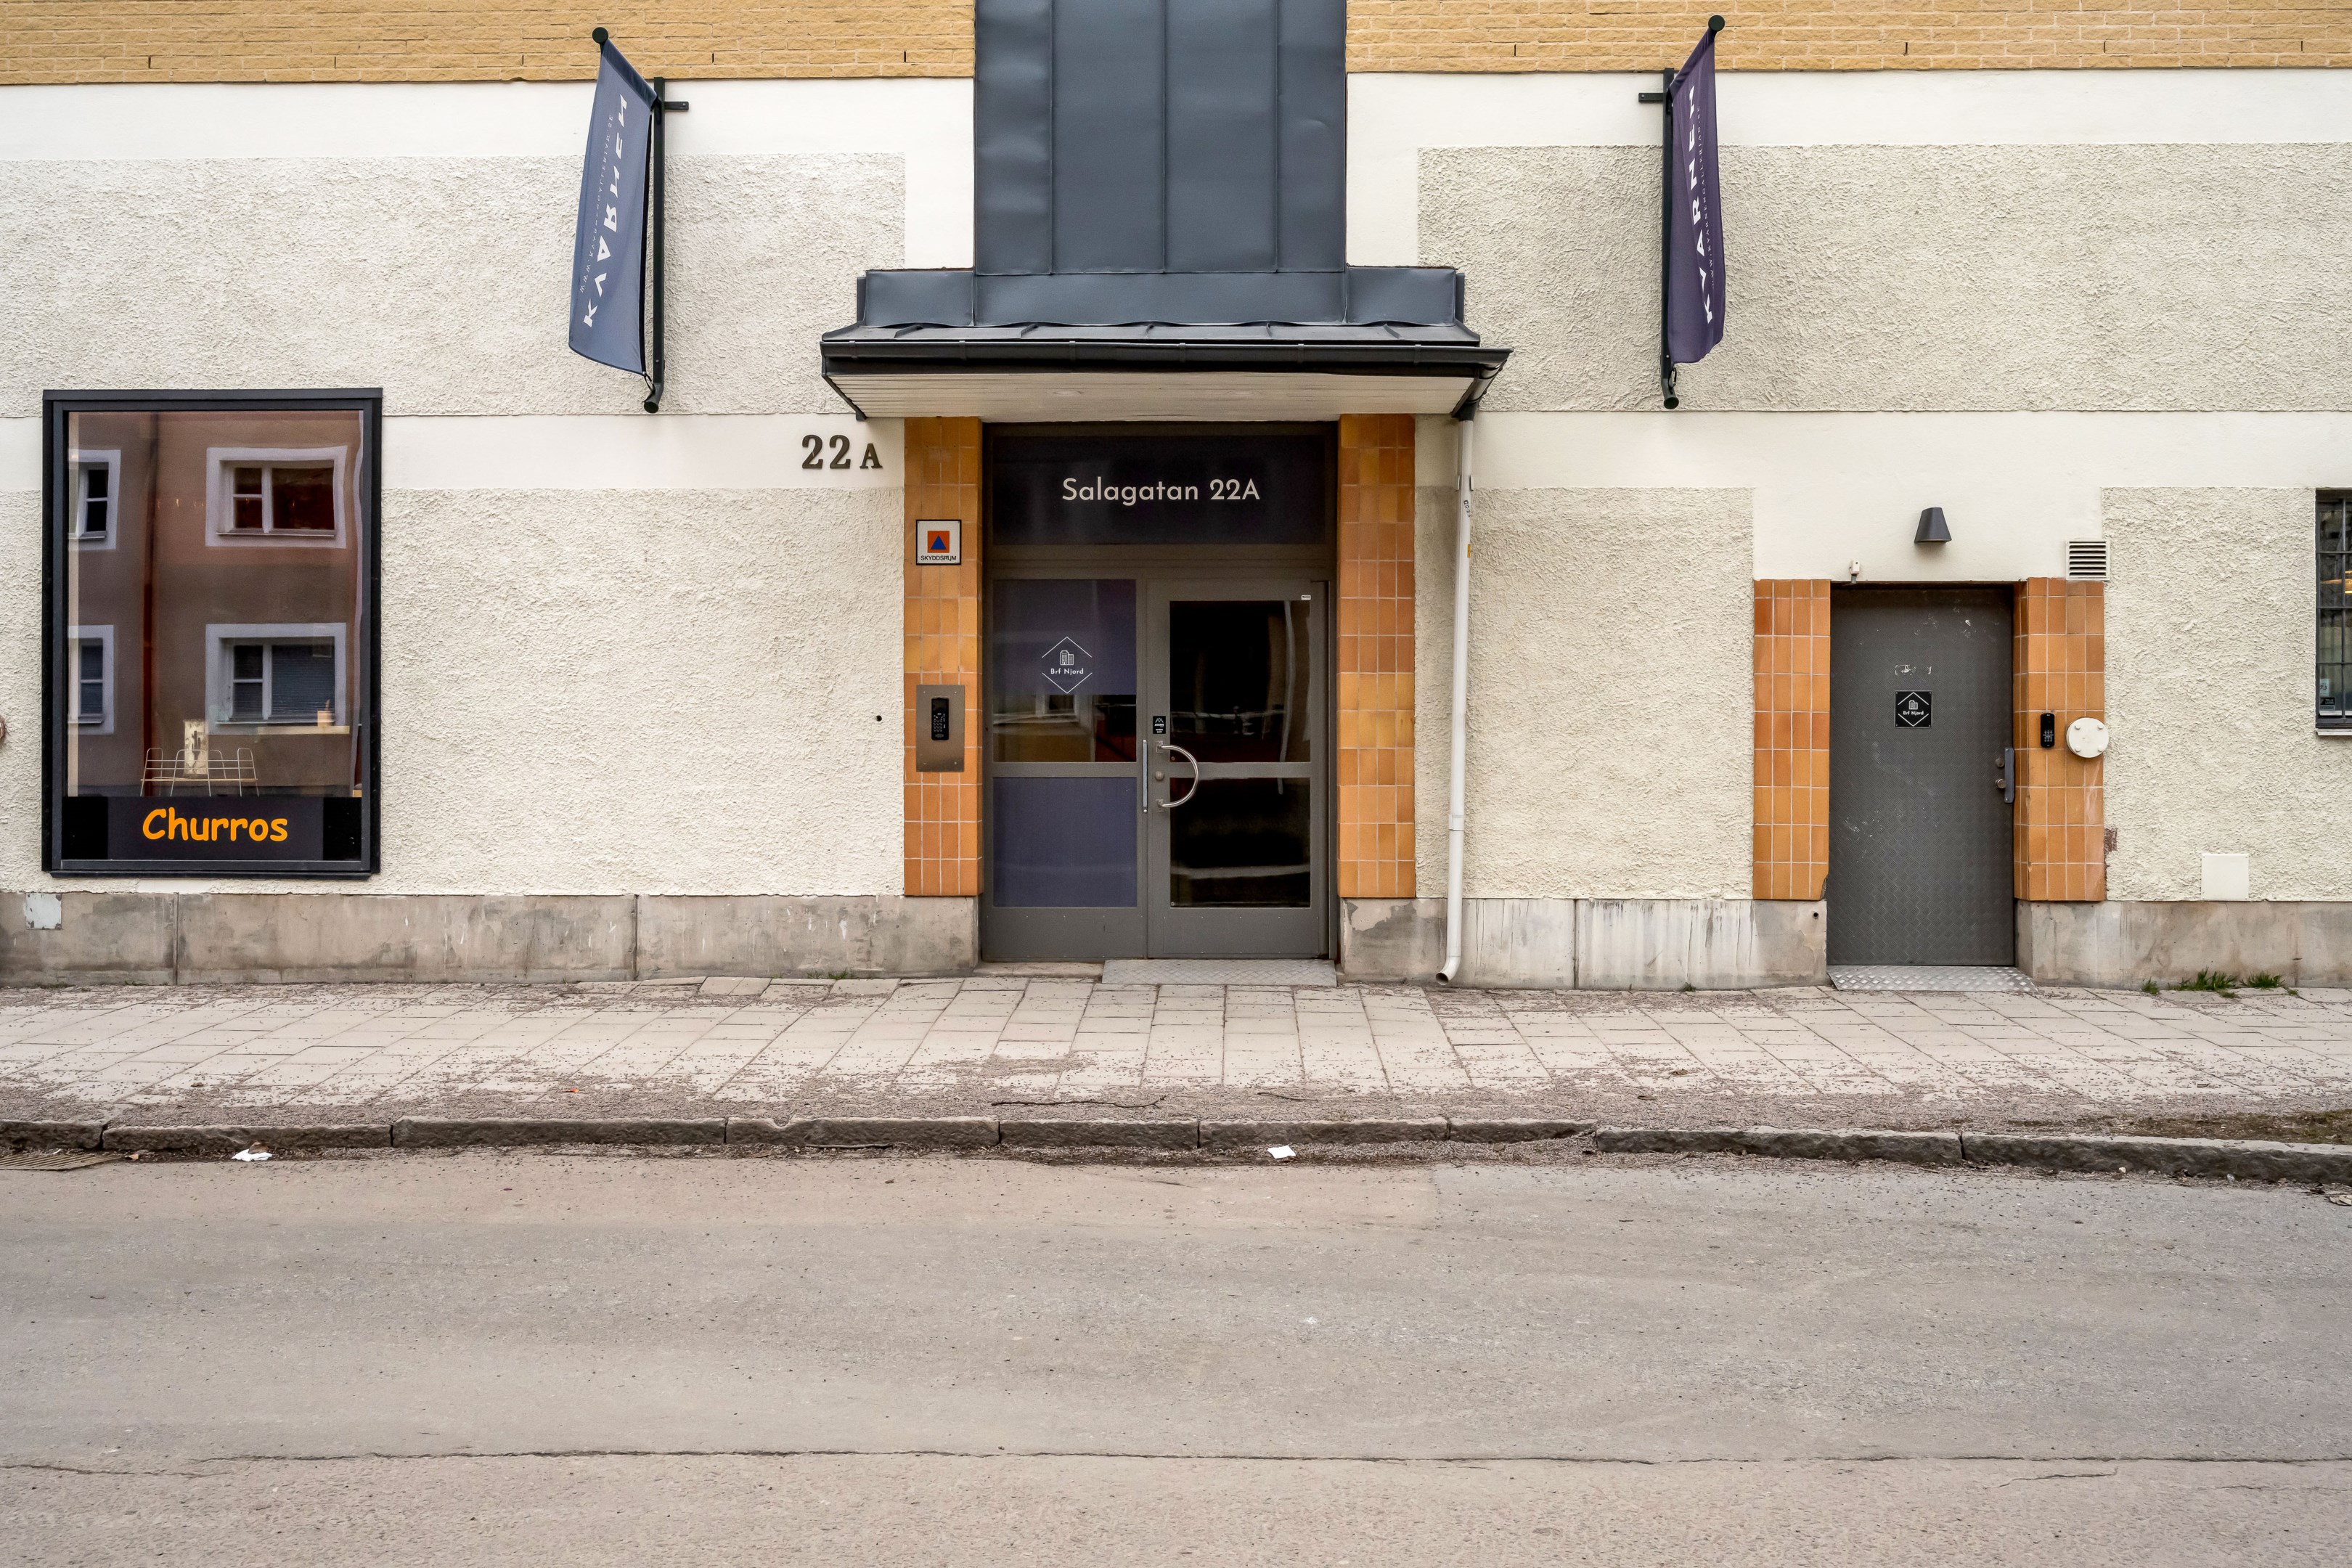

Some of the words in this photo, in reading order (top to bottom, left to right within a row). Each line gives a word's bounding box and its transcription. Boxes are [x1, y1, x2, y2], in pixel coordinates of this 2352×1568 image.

[1689, 85, 1713, 324] KVARNEN
[1062, 476, 1199, 507] Salagatan
[1209, 478, 1261, 501] 22A
[1063, 667, 1084, 676] Njord
[142, 807, 288, 842] Churros
